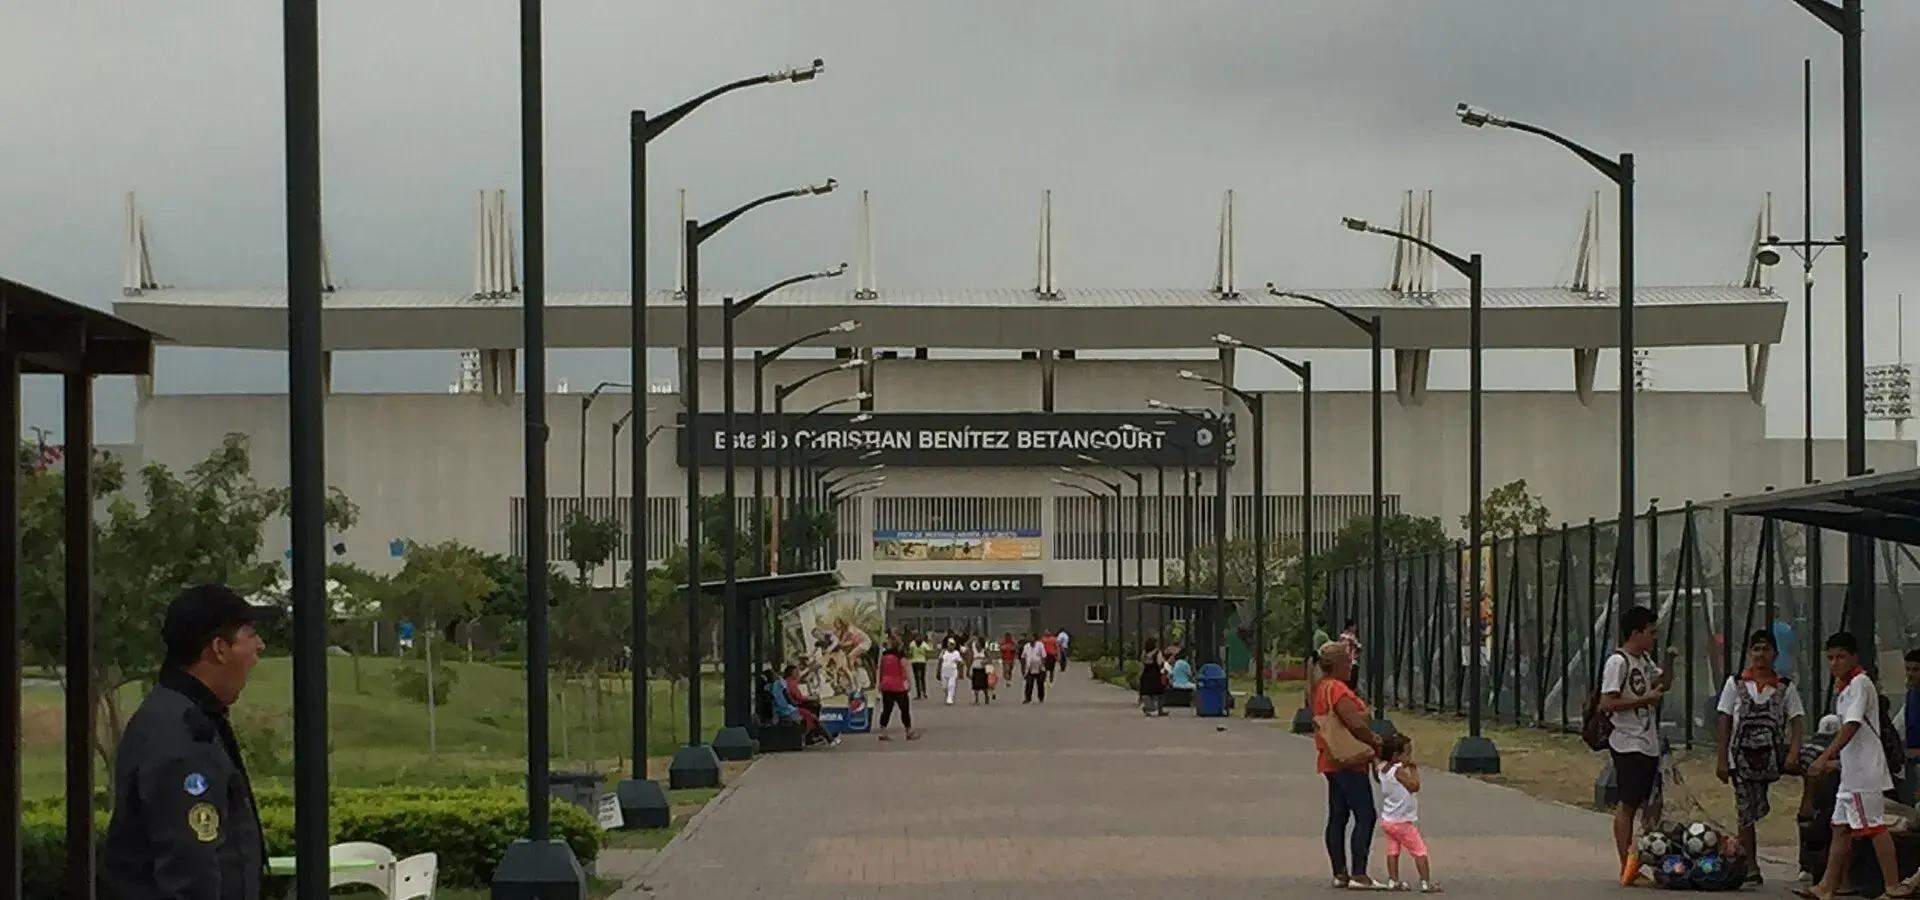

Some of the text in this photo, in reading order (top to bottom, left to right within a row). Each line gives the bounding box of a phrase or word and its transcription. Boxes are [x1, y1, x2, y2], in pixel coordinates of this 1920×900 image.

[714, 424, 1166, 449] Estadio CHRISTIAN BENÍTEZ BETANCOURT
[895, 580, 1020, 591] TRIBUNA OESTE
